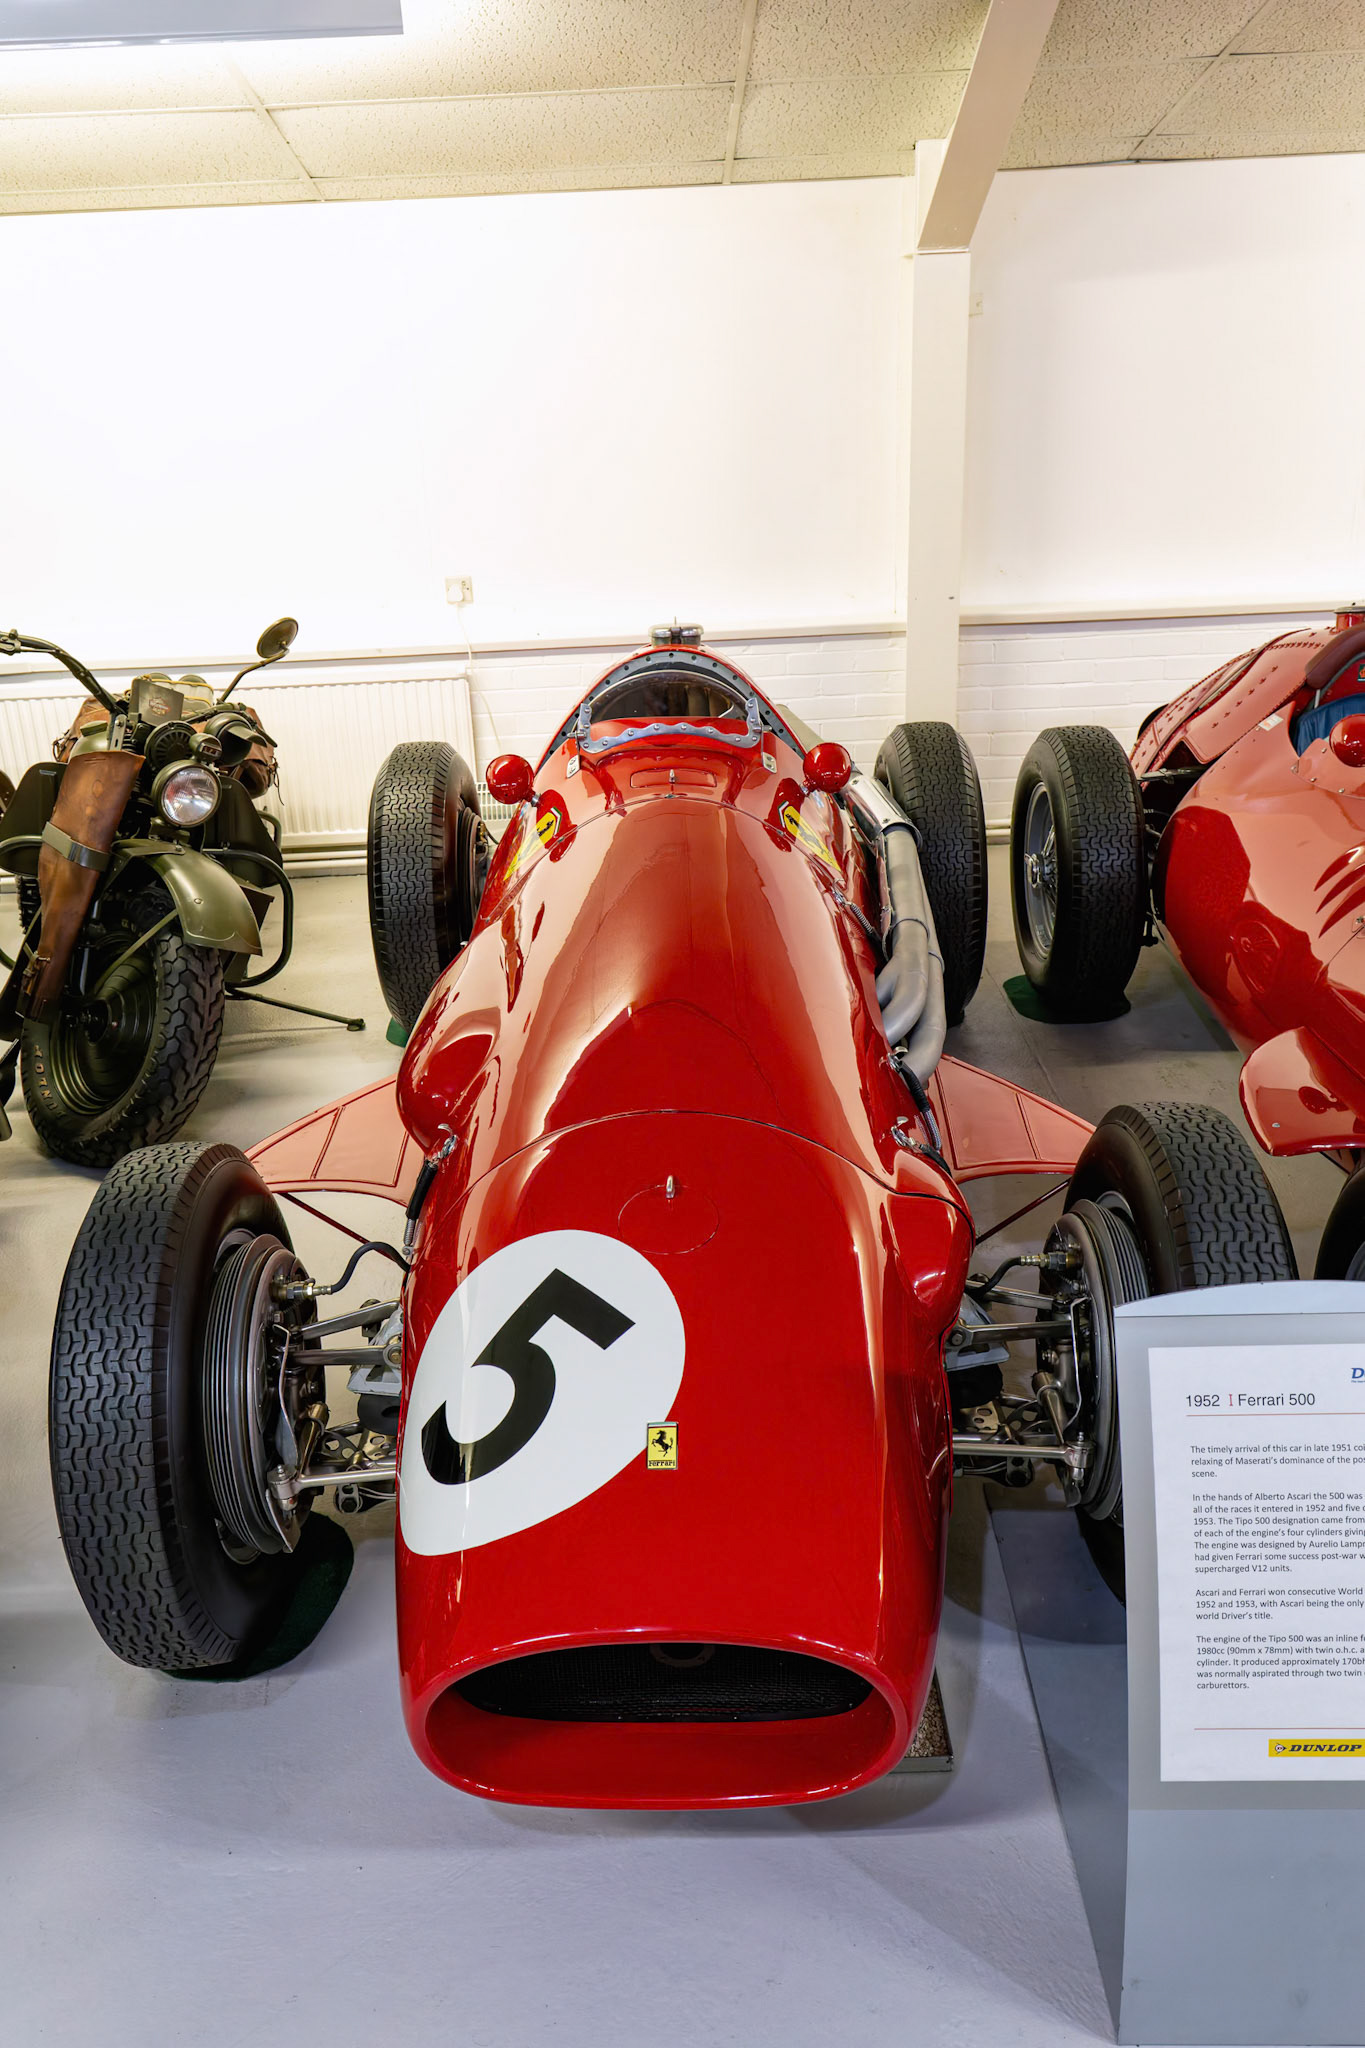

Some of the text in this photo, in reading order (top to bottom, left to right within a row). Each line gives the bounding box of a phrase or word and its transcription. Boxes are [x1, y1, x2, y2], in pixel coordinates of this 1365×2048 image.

[421, 1268, 636, 1485] 5
[1185, 1394, 1221, 1408] 1952
[1237, 1393, 1285, 1407] Ferrari
[1288, 1392, 1316, 1406] 500
[1190, 1445, 1206, 1454] The
[1207, 1445, 1233, 1455] timely
[1234, 1444, 1261, 1453] arrival
[1262, 1444, 1272, 1453] of
[1272, 1444, 1288, 1453] this
[1289, 1445, 1303, 1453] car
[1304, 1444, 1312, 1452] in
[1313, 1444, 1330, 1452] late
[1331, 1443, 1352, 1452] 1951
[648, 1459, 676, 1467] Ferrari
[1191, 1457, 1224, 1467] relaxing
[1224, 1456, 1234, 1466] of
[1279, 1456, 1325, 1465] dominance
[1326, 1455, 1336, 1464] of
[1336, 1455, 1351, 1464] the
[1192, 1494, 1201, 1502] In
[1202, 1493, 1217, 1502] the
[1218, 1493, 1243, 1502] hands
[1244, 1492, 1253, 1501] of
[1254, 1492, 1286, 1501] Alberto
[1286, 1492, 1312, 1501] Ascari
[1313, 1492, 1328, 1500] the
[1329, 1491, 1345, 1500] 500
[1193, 1505, 1203, 1514] all
[1204, 1504, 1213, 1514] of
[1214, 1505, 1229, 1514] the
[1253, 1505, 1260, 1513] it
[1261, 1504, 1294, 1513] entered
[1295, 1504, 1304, 1512] in
[1306, 1504, 1326, 1513] 1952
[1327, 1503, 1344, 1512] and
[1345, 1503, 1361, 1512] five
[1194, 1517, 1216, 1526] 1953.
[1217, 1517, 1234, 1525] The
[1235, 1517, 1253, 1527] Tipo
[1255, 1516, 1271, 1525] 500
[1272, 1516, 1320, 1526] designation
[1345, 1515, 1365, 1524] from
[1193, 1529, 1203, 1538] of
[1204, 1529, 1224, 1538] each
[1225, 1528, 1234, 1537] of
[1235, 1528, 1250, 1537] the
[1287, 1528, 1305, 1537] four
[1306, 1528, 1343, 1538] cylinders
[1193, 1541, 1210, 1550] The
[1211, 1542, 1239, 1551] engine
[1258, 1540, 1295, 1551] designed
[1296, 1540, 1307, 1550] by
[1308, 1539, 1339, 1548] Aurelio
[1194, 1553, 1210, 1562] had
[1211, 1553, 1234, 1563] given
[1235, 1552, 1263, 1561] Ferrari
[1288, 1553, 1320, 1561] success
[1321, 1552, 1358, 1562] post-war
[1194, 1564, 1293, 1575] supercharged V12 units.
[1195, 1588, 1220, 1597] Ascari
[1221, 1588, 1238, 1597] and
[1239, 1588, 1266, 1596] Ferrari
[1287, 1587, 1336, 1596] consecutive
[1337, 1587, 1364, 1596] World
[1196, 1598, 1365, 1609] 1952 and 1953, with Ascari being the only
[1195, 1612, 1220, 1620] world
[1254, 1611, 1273, 1620] title.
[1196, 1635, 1212, 1643] The
[1213, 1635, 1241, 1645] engine
[1242, 1634, 1252, 1643] of
[1252, 1635, 1267, 1643] the
[1268, 1634, 1287, 1644] Tipo
[1288, 1634, 1304, 1643] 500
[1335, 1634, 1359, 1642] inline
[1197, 1646, 1225, 1655] 1980cc
[1226, 1646, 1256, 1656] (90mm
[1264, 1646, 1294, 1656] 78mm)
[1295, 1646, 1314, 1654] with
[1315, 1646, 1334, 1654] twin
[1335, 1646, 1358, 1654] o.h.c.
[1196, 1658, 1232, 1668] cylinder.
[1233, 1658, 1239, 1666] It
[1241, 1657, 1280, 1668] produced
[1281, 1657, 1341, 1667] approximately
[1214, 1669, 1251, 1679] normally
[1251, 1669, 1290, 1679] aspirated
[1291, 1669, 1325, 1679] through
[1325, 1669, 1343, 1677] two
[1343, 1669, 1363, 1677] twin
[1196, 1681, 1250, 1690] carburettors.
[1289, 1744, 1362, 1752] DUNLOP
